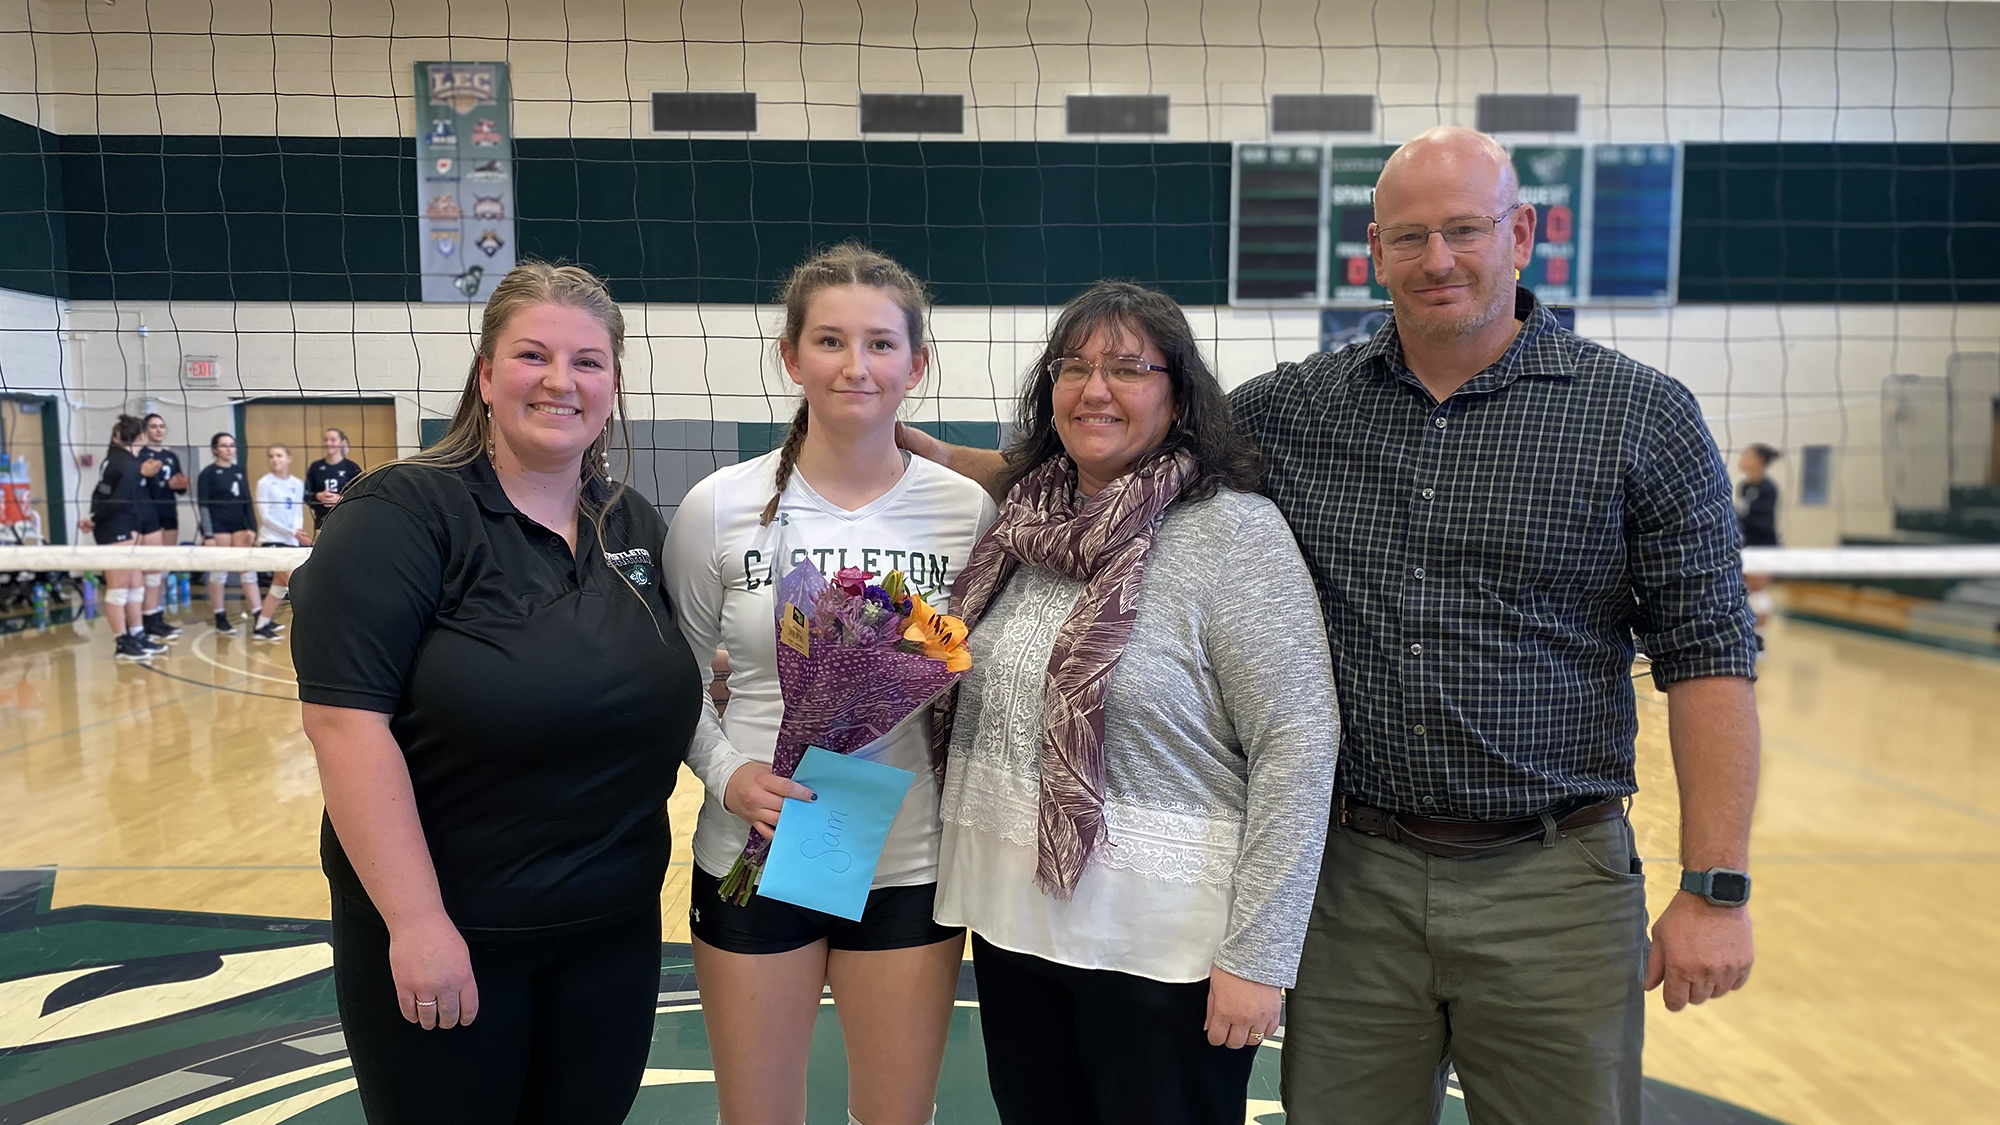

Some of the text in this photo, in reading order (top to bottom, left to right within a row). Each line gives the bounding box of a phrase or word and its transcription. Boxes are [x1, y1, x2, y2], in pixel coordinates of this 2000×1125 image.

[433, 73, 490, 92] LEC
[231, 481, 240, 496] 4
[325, 479, 338, 492] 12
[800, 810, 852, 873] Sam
